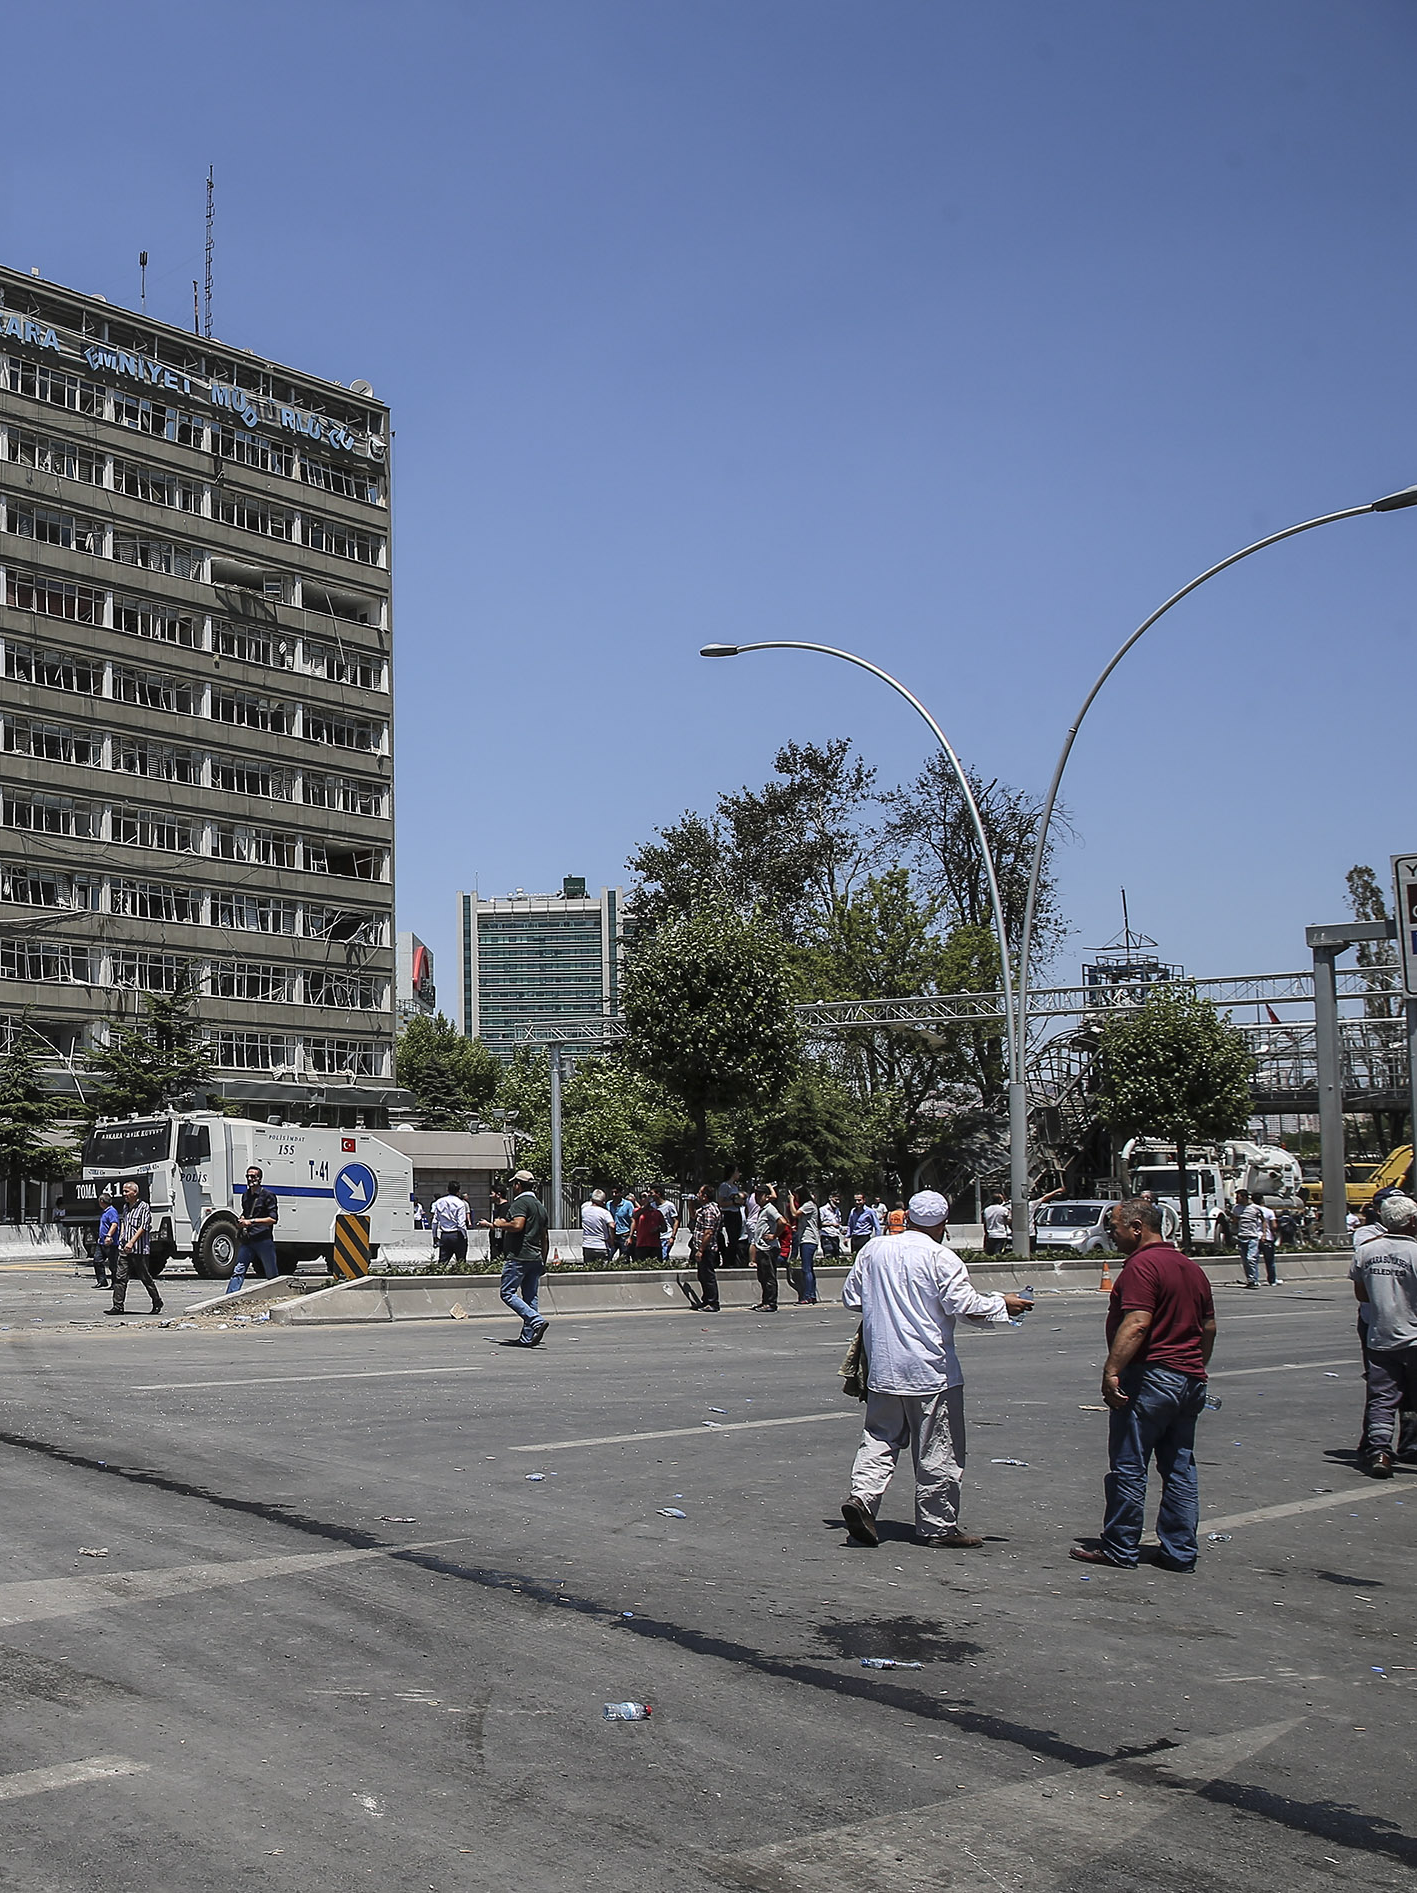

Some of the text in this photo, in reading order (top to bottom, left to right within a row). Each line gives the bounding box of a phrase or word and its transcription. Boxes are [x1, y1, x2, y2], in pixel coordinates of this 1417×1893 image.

[83, 345, 192, 394] EMNİYET
[278, 1144, 295, 1156] 155
[180, 1171, 208, 1184] POLİS
[308, 1160, 329, 1182] T-41
[75, 1182, 123, 1199] TOMA 41
